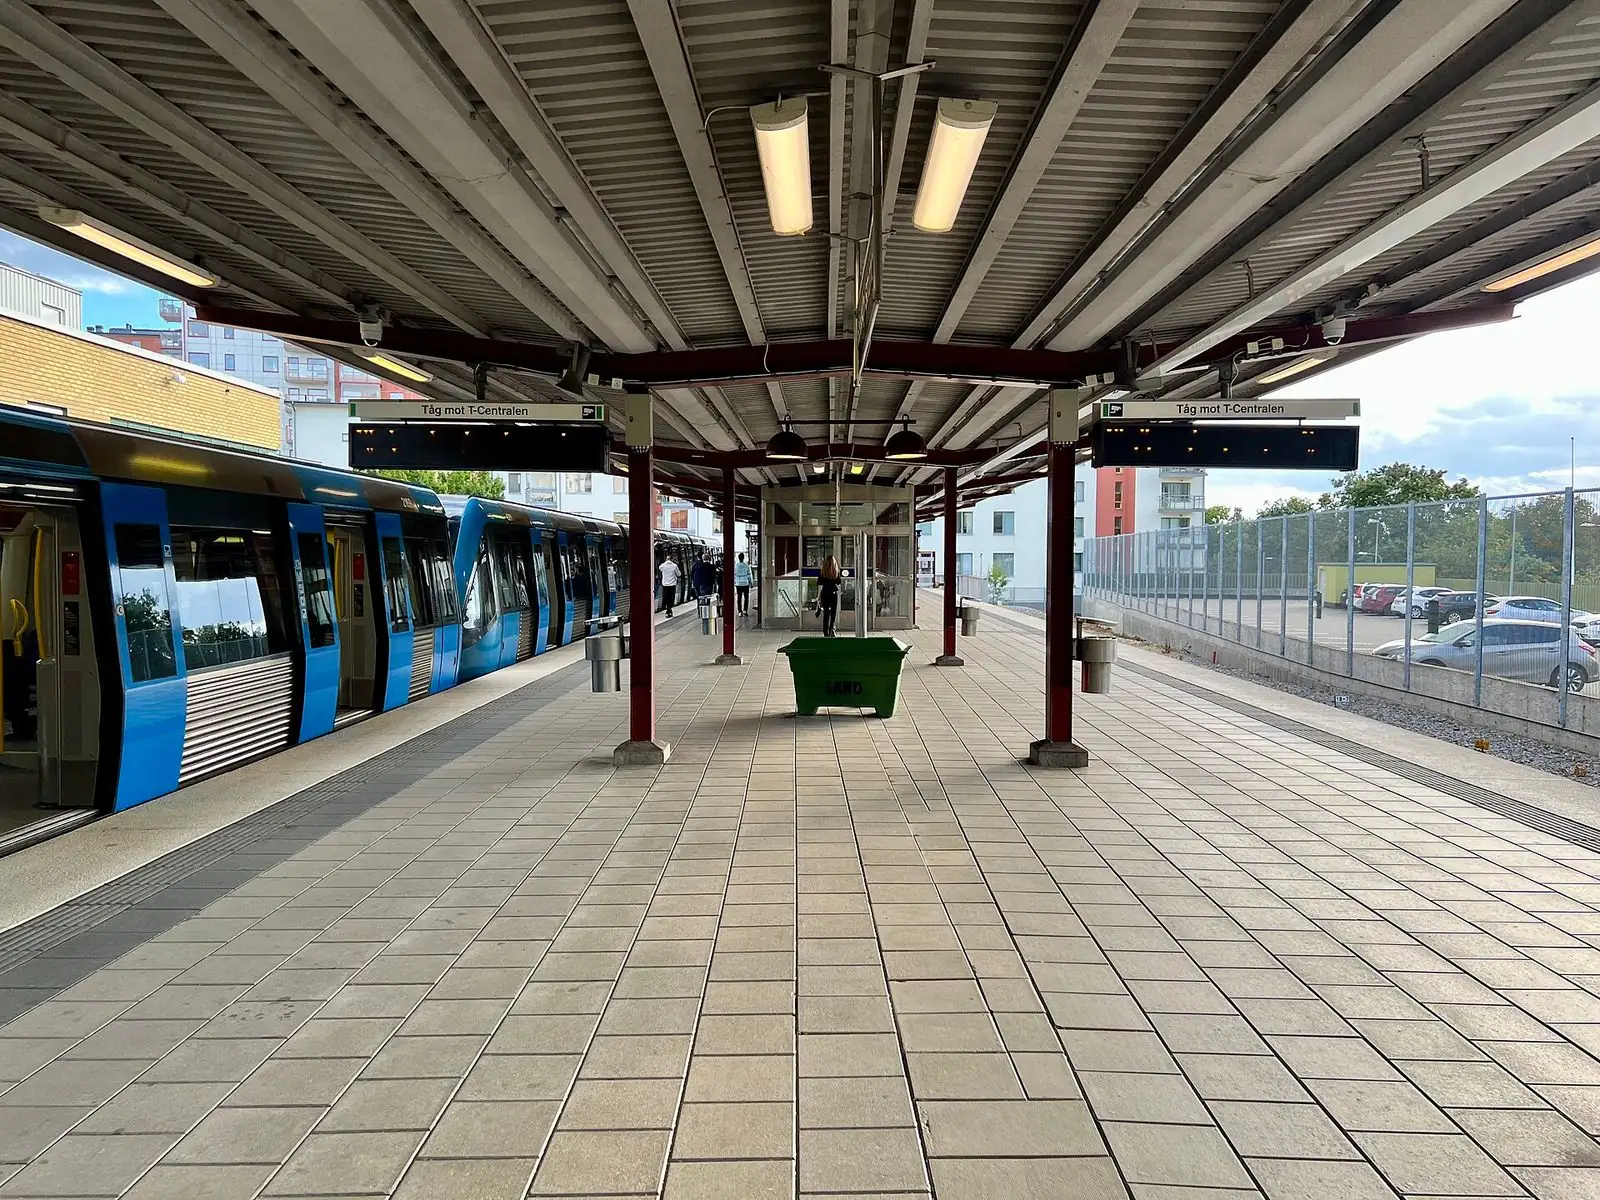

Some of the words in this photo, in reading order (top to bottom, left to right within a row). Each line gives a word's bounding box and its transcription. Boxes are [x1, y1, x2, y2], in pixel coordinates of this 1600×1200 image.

[422, 404, 442, 416] Tåg
[444, 406, 465, 414] mot
[468, 405, 528, 415] T-Centralen
[1176, 404, 1197, 416] Tåg
[1199, 404, 1221, 414] mot
[1223, 403, 1284, 414] T-Centralen
[825, 681, 863, 694] SAND
